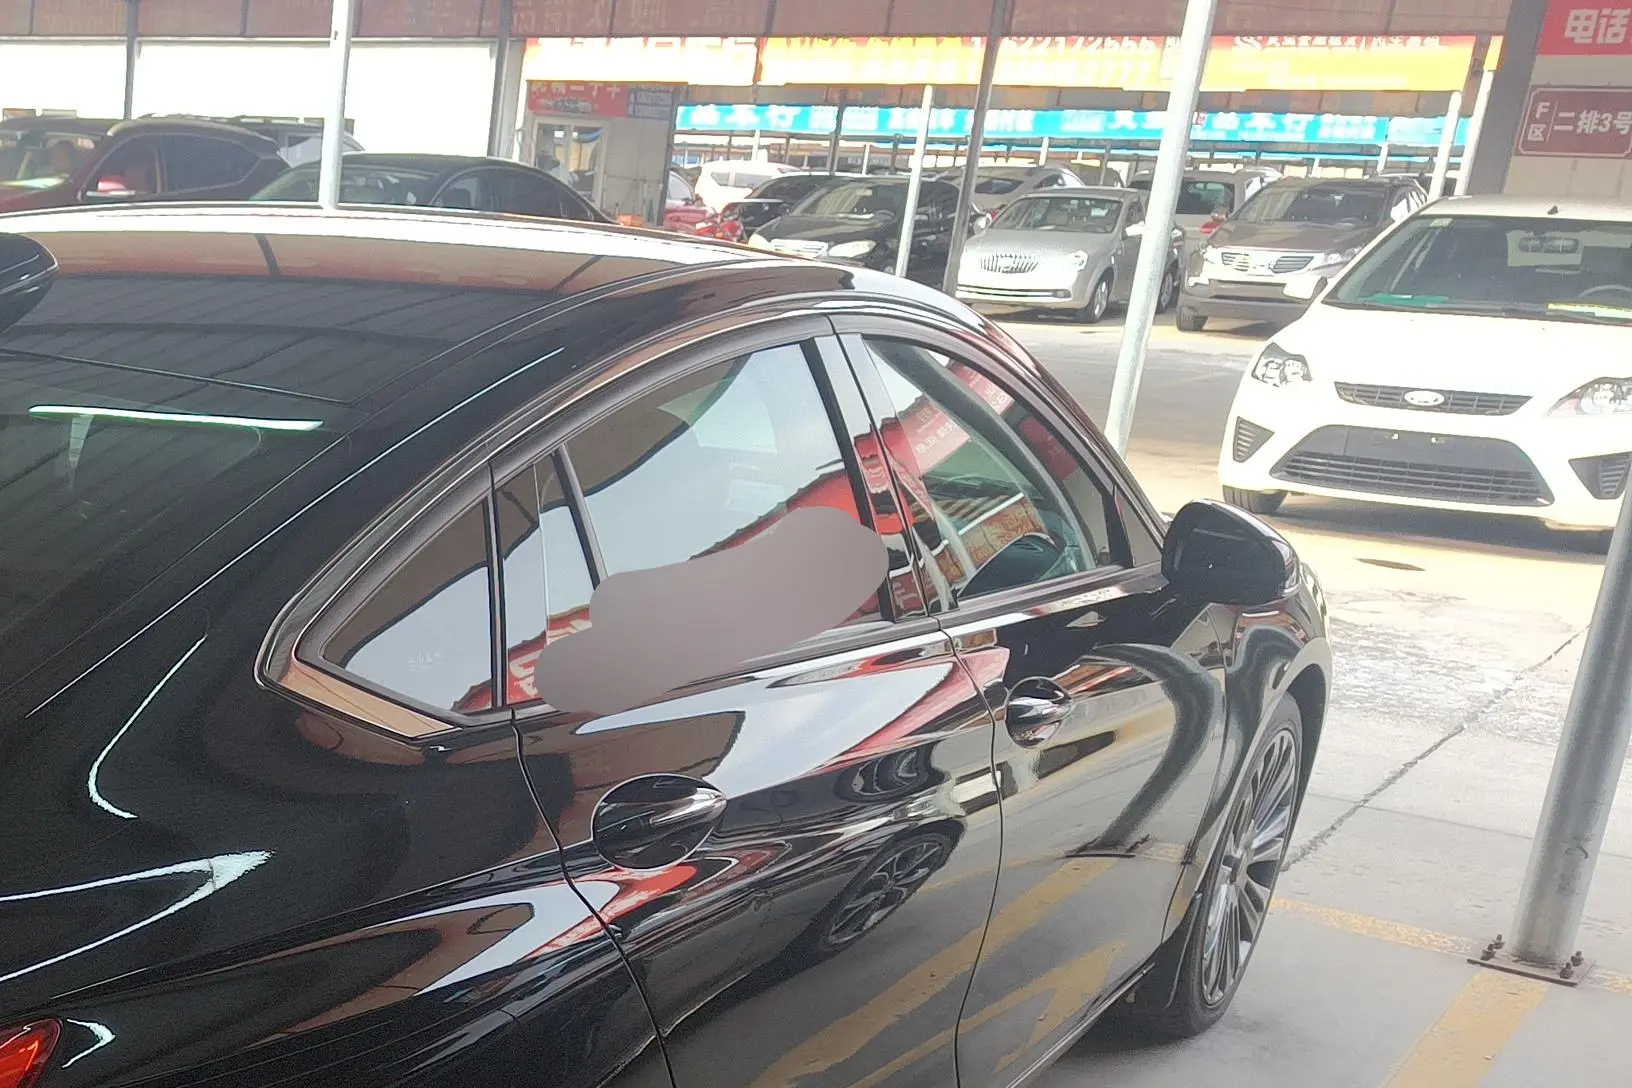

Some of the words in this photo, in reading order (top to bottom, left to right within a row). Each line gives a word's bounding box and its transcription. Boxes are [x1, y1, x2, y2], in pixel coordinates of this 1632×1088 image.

[1564, 8, 1631, 44] 电话
[1553, 109, 1632, 136] 二排3号
